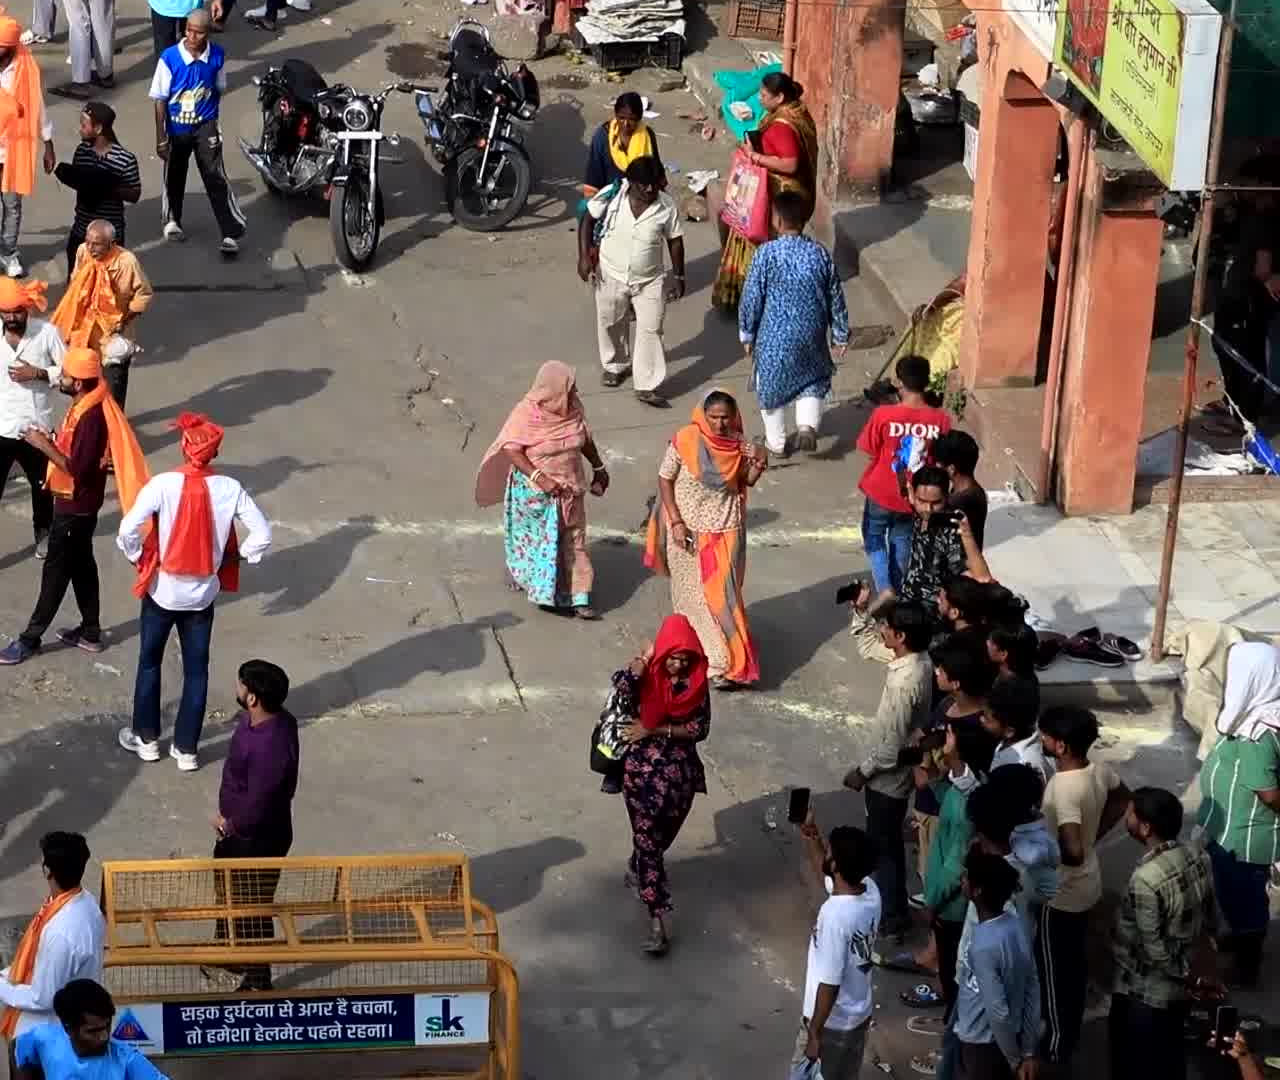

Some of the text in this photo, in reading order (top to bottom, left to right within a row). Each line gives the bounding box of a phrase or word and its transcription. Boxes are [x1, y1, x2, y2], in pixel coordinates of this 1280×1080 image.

[1137, 31, 1165, 73] हनुमान
[889, 421, 940, 440] DIOR
[181, 997, 397, 1026] सड़क दुर्घटना से अगर है बचना,
[425, 998, 465, 1031] sk
[185, 1020, 393, 1046] तो हमेशा हेलमेट पहने रहना।
[425, 1029, 466, 1039] FINANCE
